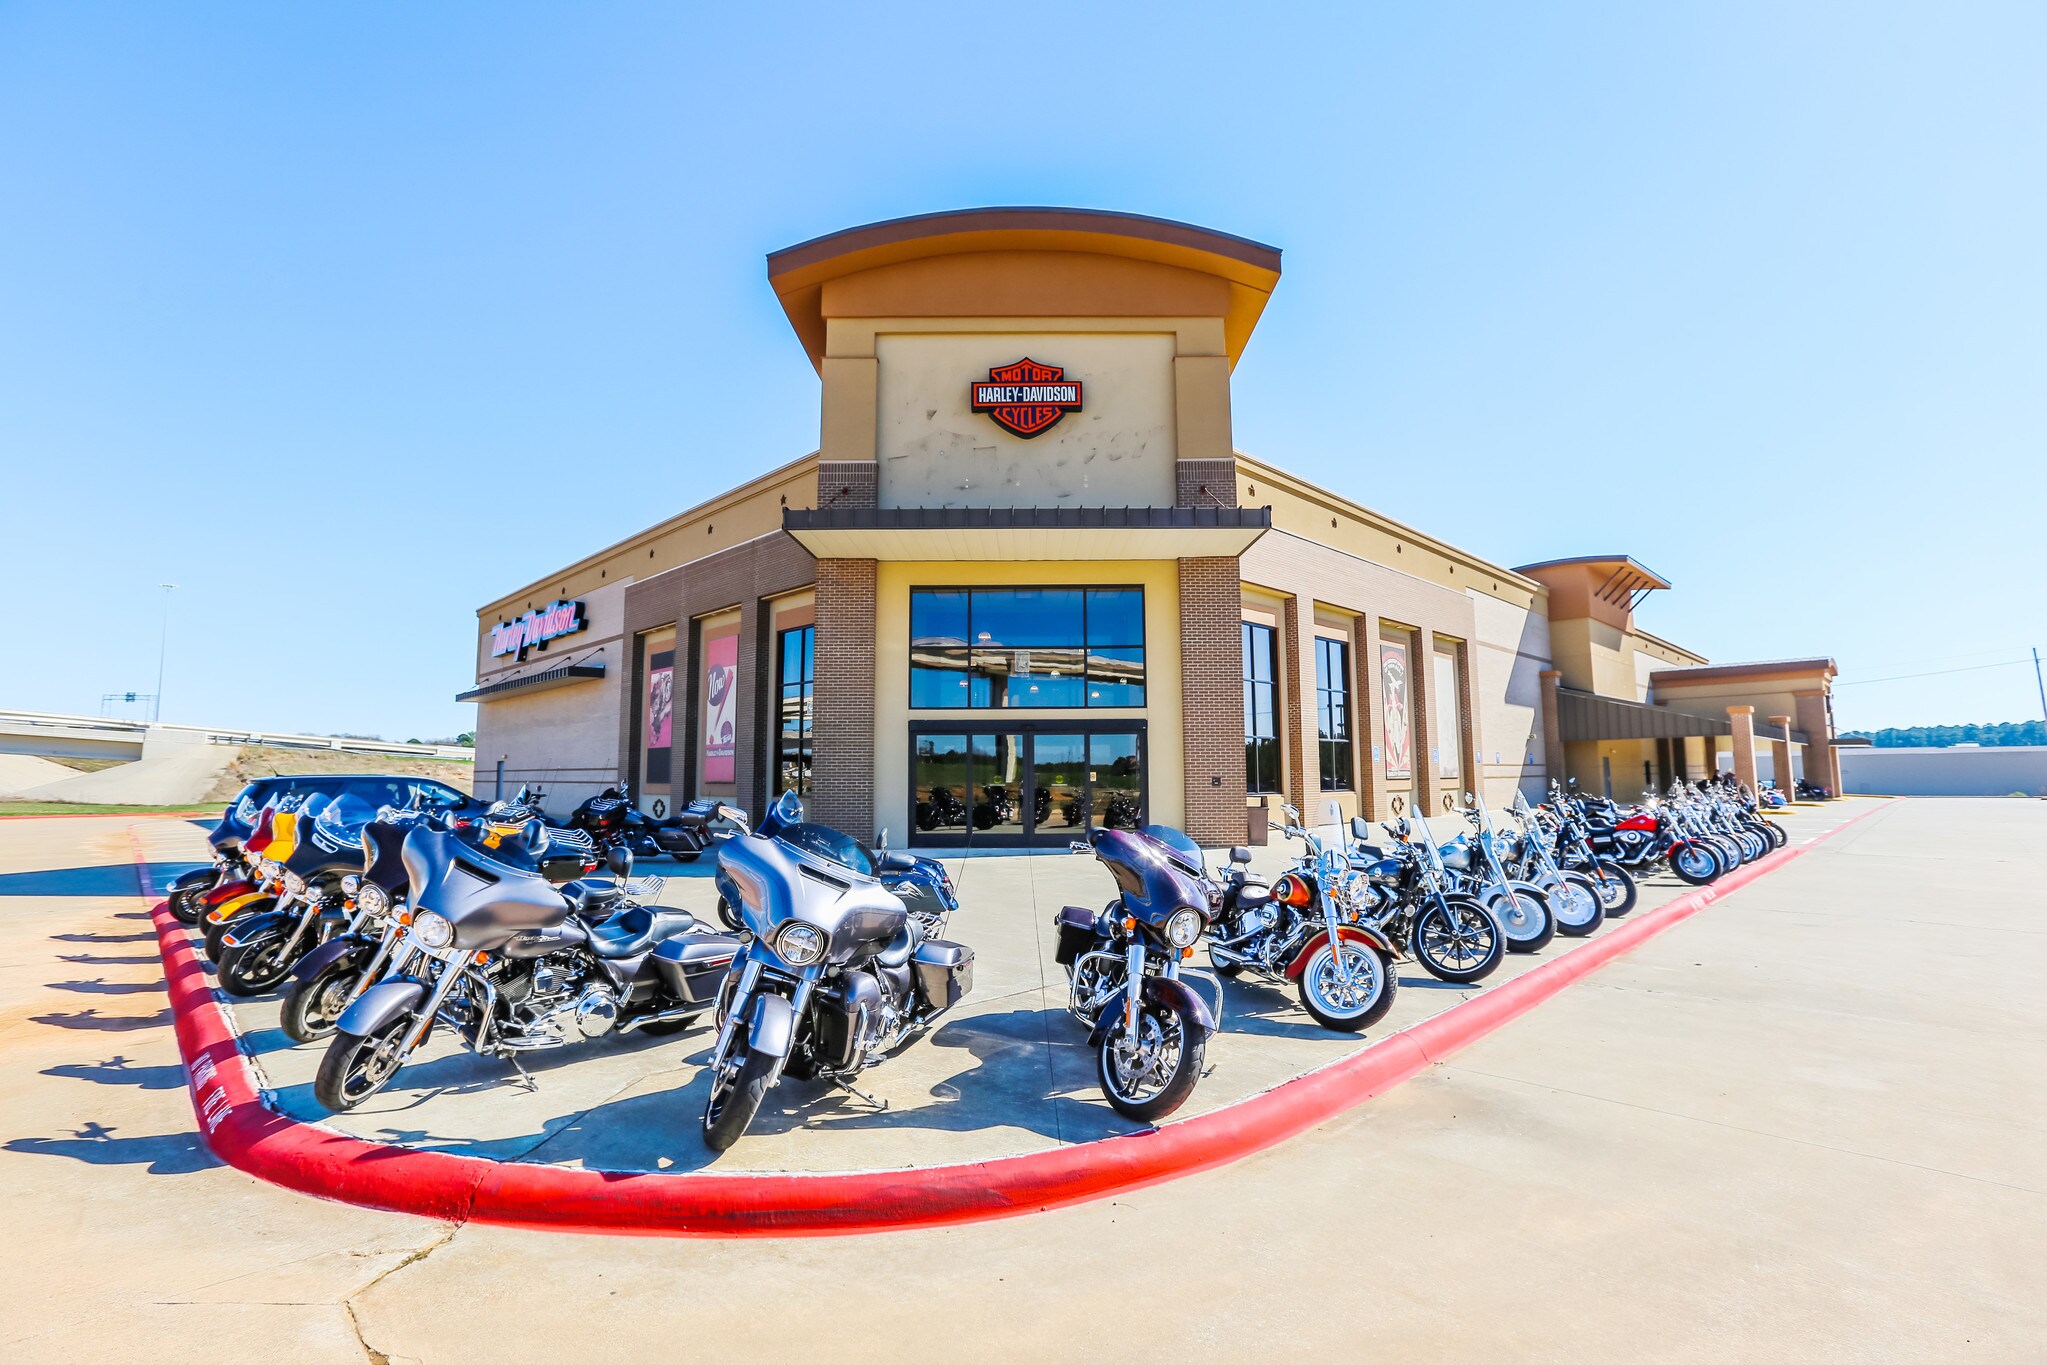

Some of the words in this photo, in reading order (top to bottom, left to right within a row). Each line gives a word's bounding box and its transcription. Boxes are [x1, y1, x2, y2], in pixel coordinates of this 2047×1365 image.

[1001, 363, 1052, 381] MOTOR
[978, 386, 1076, 403] HARLEY-DAVIDSON
[1002, 407, 1052, 429] CYCLES
